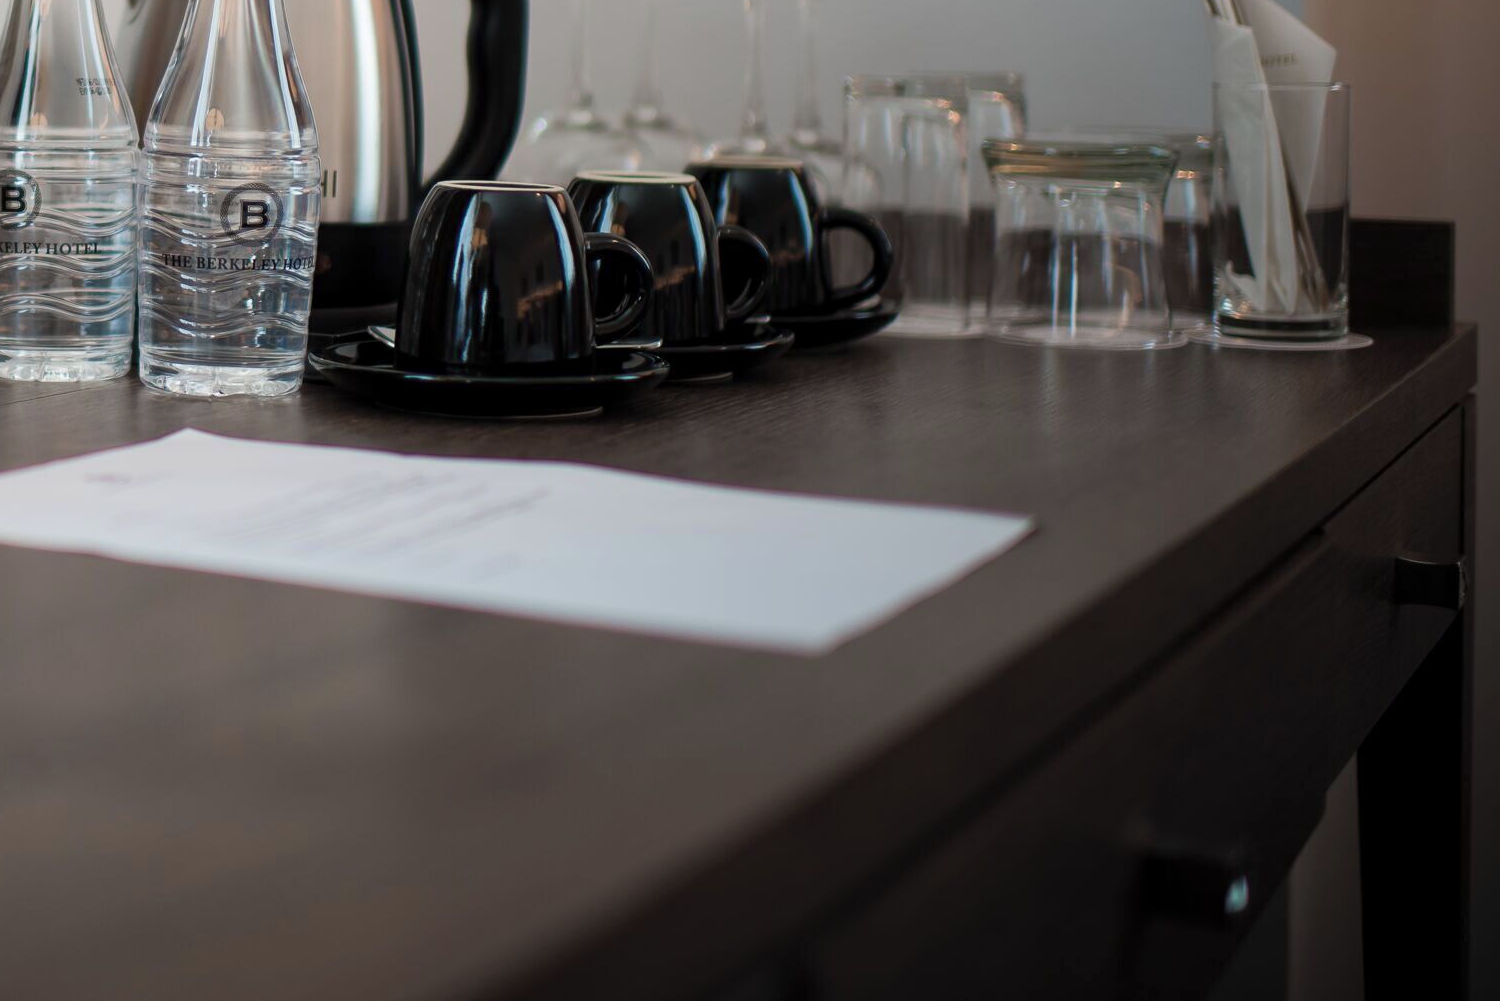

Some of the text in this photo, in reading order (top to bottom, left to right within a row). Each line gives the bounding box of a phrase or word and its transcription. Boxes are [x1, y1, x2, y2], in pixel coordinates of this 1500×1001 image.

[0, 185, 27, 212] B
[240, 199, 270, 229] B
[45, 242, 101, 255] HOTEL
[162, 253, 192, 268] THE
[196, 256, 280, 271] BERKELEY
